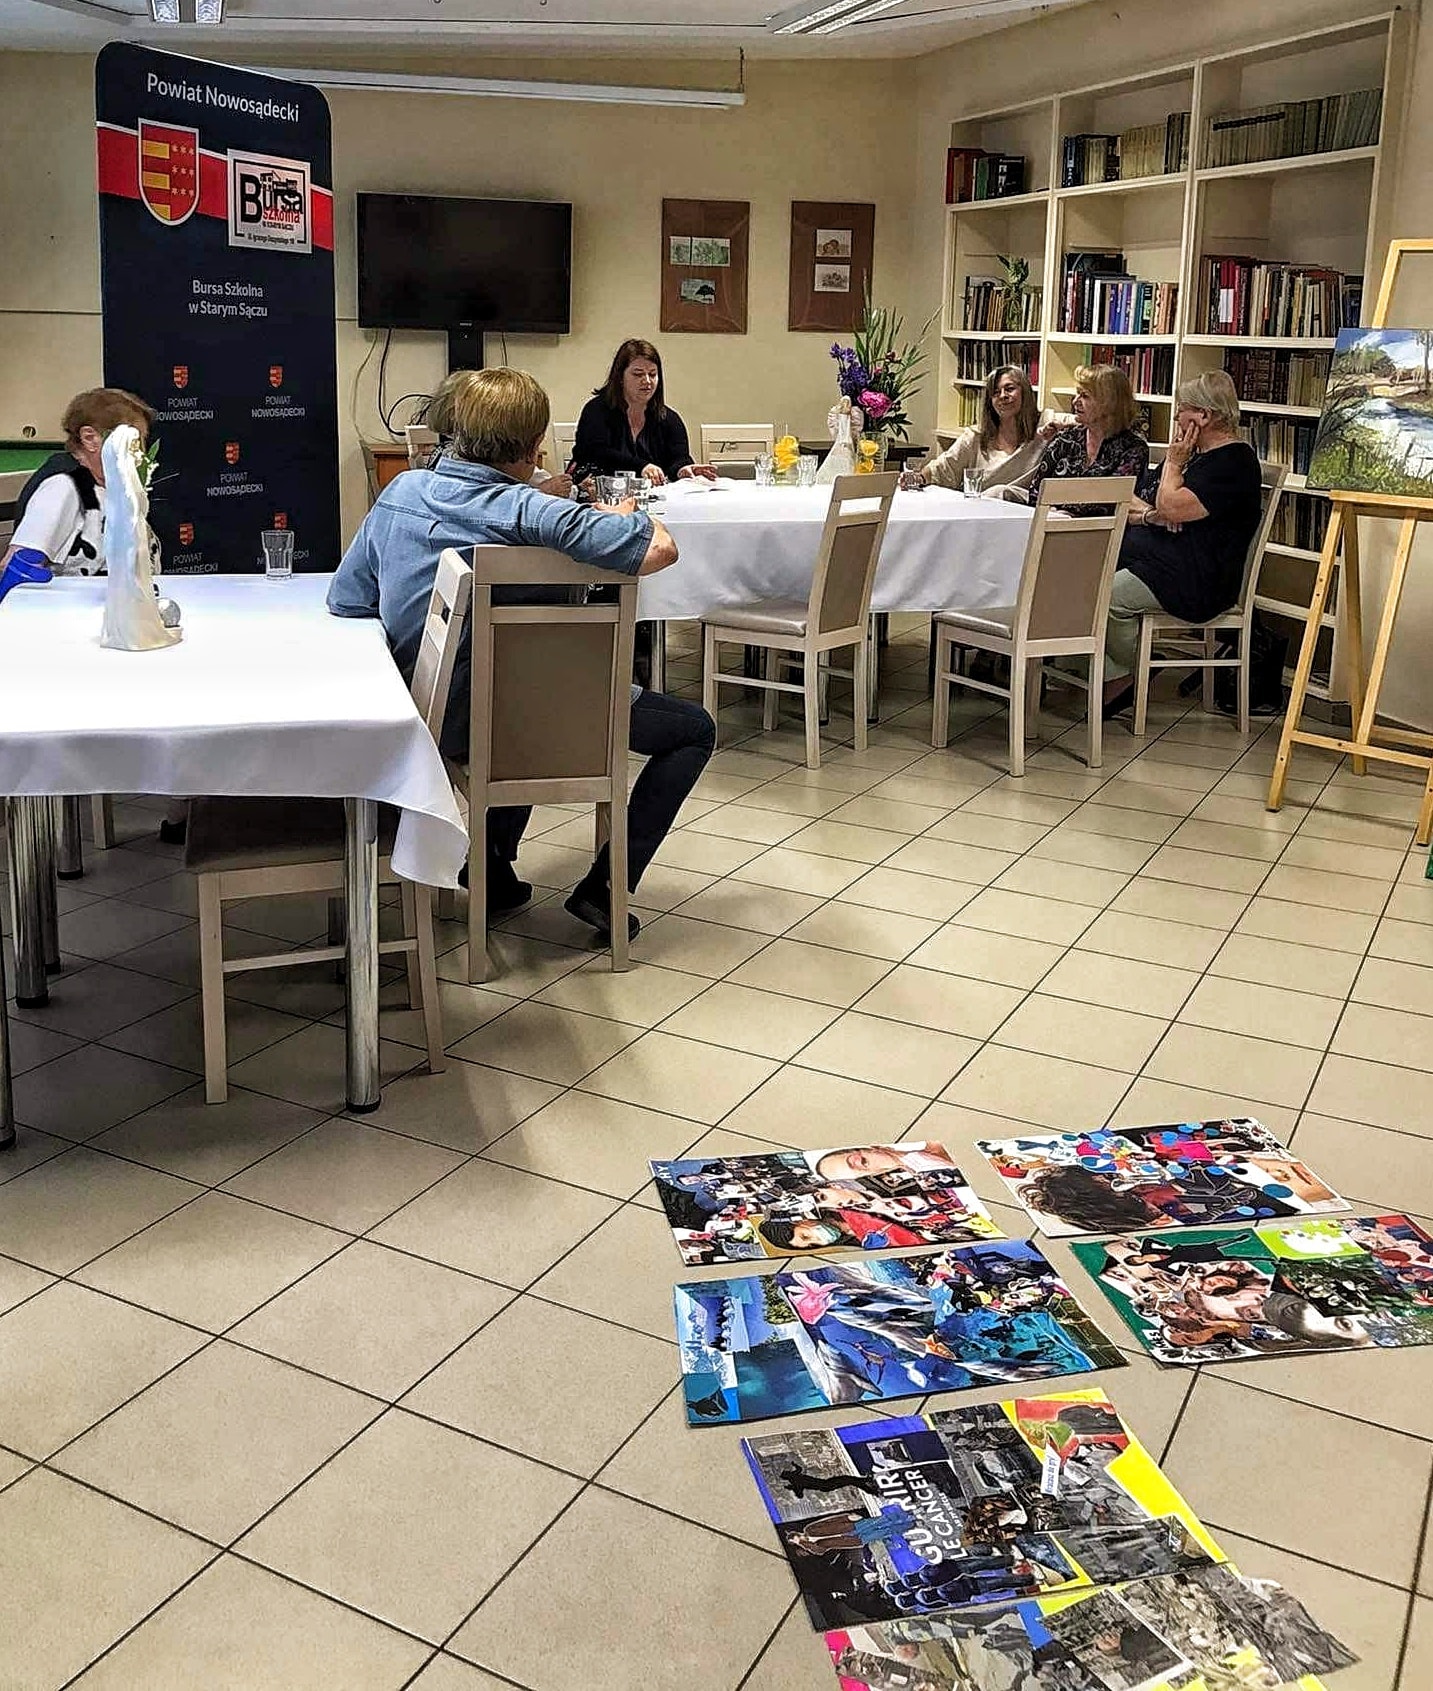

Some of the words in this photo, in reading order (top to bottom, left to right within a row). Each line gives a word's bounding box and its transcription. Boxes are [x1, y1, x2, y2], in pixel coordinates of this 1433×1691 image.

[147, 72, 202, 103] Powiat
[205, 84, 299, 122] Nowosądecki
[192, 279, 223, 295] Bursa
[224, 281, 263, 297] Szkolna
[188, 302, 199, 314] w
[200, 300, 238, 318] Starym
[239, 302, 268, 319] Sączu
[167, 397, 198, 408] POWIAT
[265, 395, 292, 405] POWIAT
[251, 407, 306, 419] NOWOSĄDECKI
[220, 471, 248, 483] POWIAT
[206, 483, 264, 496] NOWOSĄDECKI
[172, 552, 203, 565] POWIAT
[904, 1469, 954, 1537] CANCER
[875, 1472, 943, 1565] GURIR
[942, 1538, 969, 1560] LE
